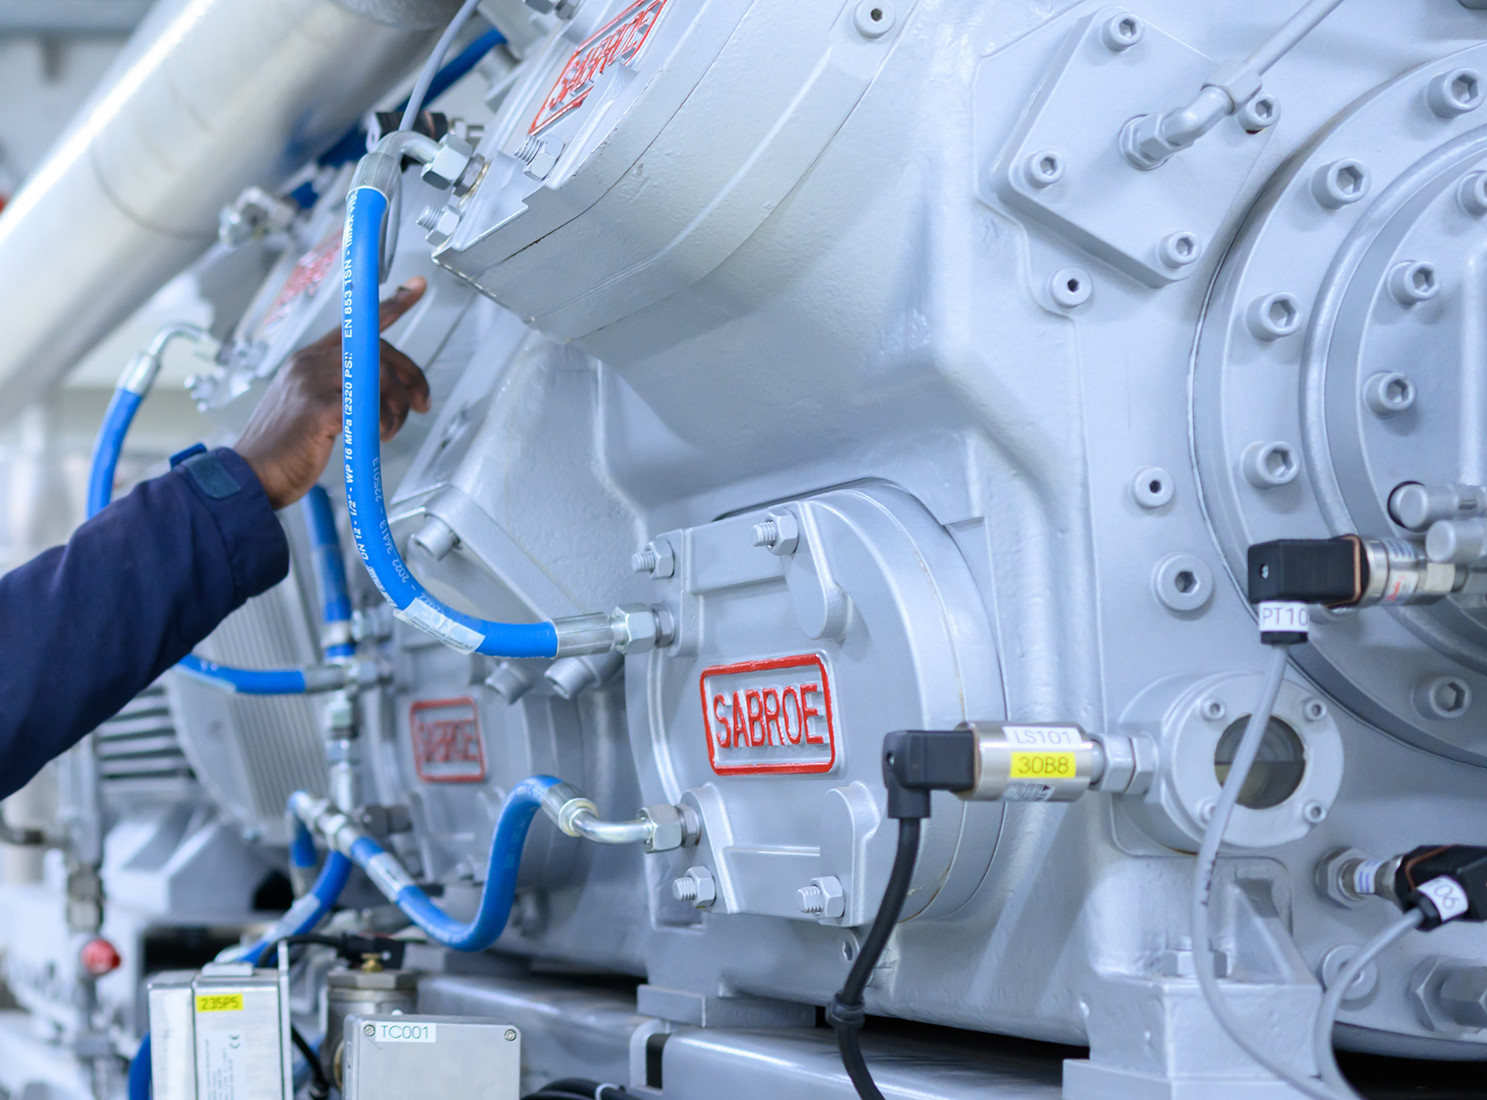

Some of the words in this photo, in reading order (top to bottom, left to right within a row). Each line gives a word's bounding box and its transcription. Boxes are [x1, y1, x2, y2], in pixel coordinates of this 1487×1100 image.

[344, 290, 353, 314] 853
[344, 319, 353, 338] EN
[344, 382, 353, 415] (2320
[344, 419, 353, 445] MPa
[345, 448, 353, 460] 16
[345, 464, 354, 484] WP
[353, 527, 362, 540] 12
[357, 543, 369, 561] DN
[392, 558, 410, 583] 2022
[713, 683, 825, 748] SABROE
[1014, 730, 1072, 745] LS101
[1018, 756, 1069, 775] 30B8
[380, 1025, 429, 1040] TC001
